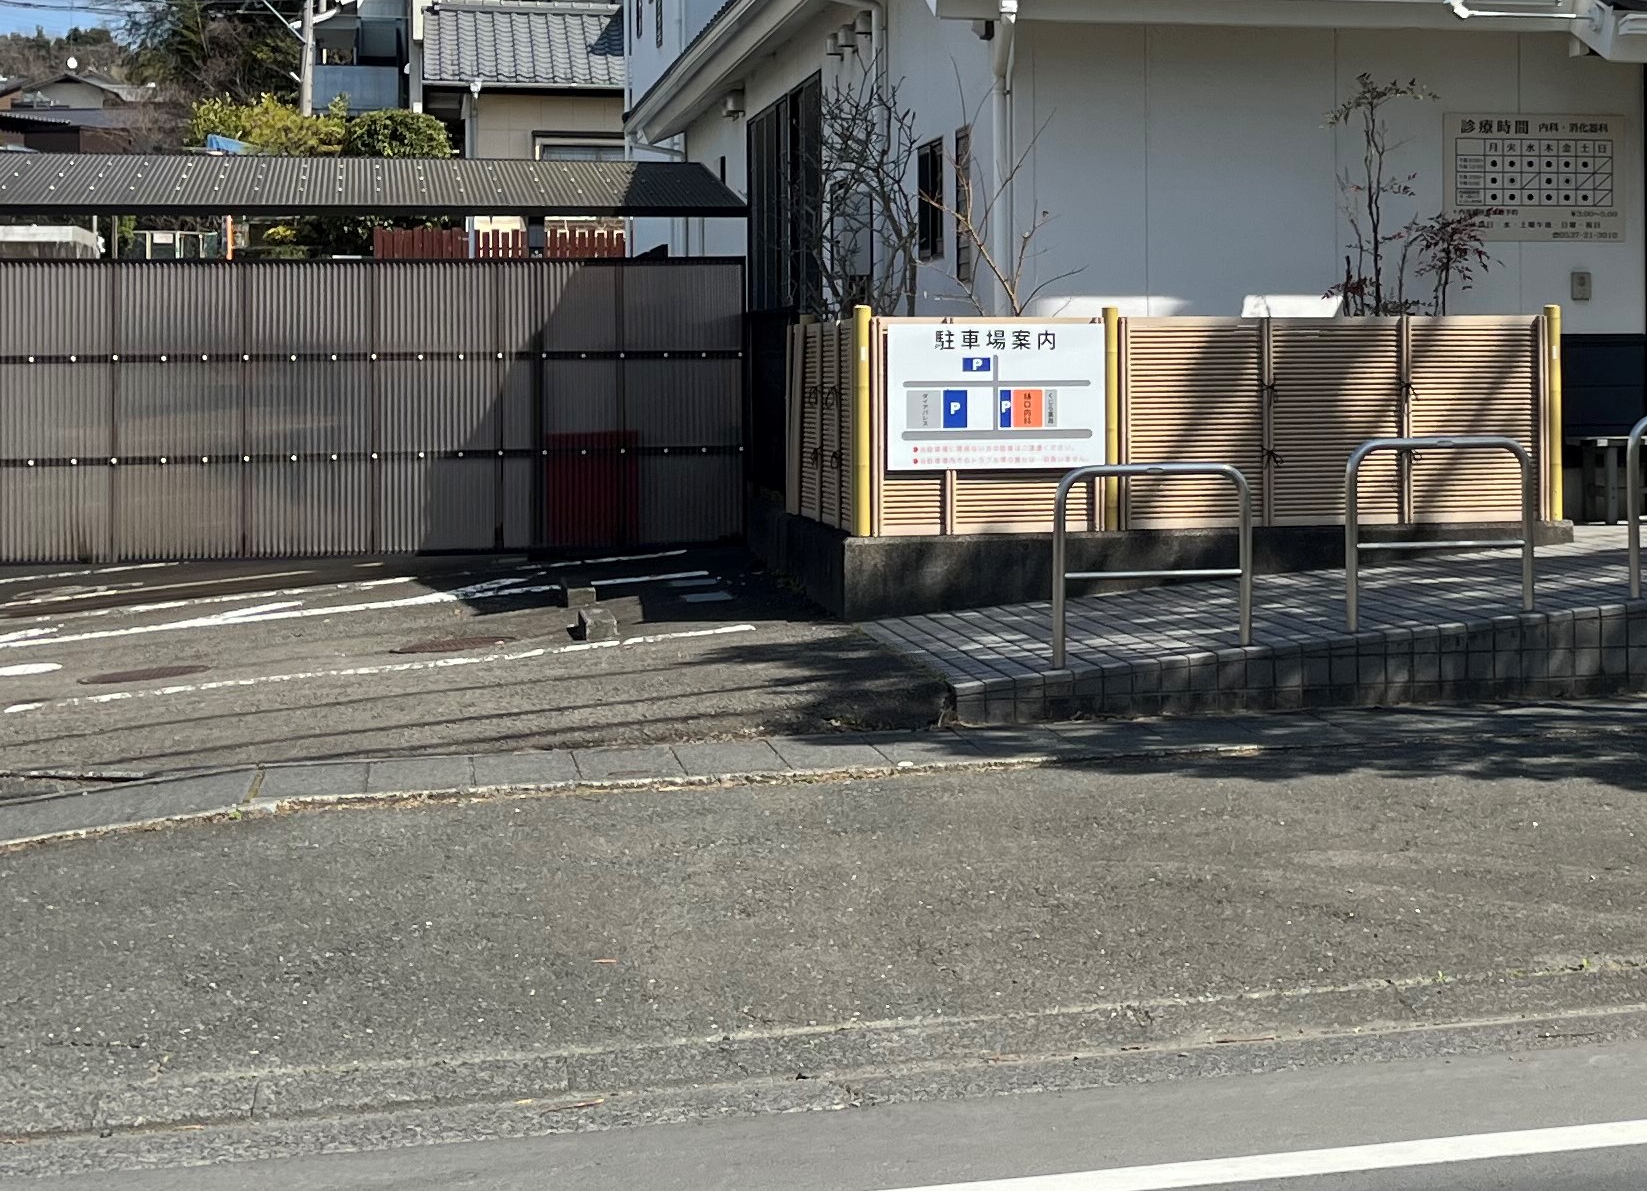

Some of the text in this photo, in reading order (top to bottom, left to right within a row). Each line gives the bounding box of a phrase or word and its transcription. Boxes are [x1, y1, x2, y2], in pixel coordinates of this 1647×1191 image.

[1460, 119, 1529, 135] 診療時間
[1489, 143, 1498, 152] 月
[1562, 143, 1572, 153] 金
[1581, 144, 1590, 153] 土
[1598, 144, 1607, 153] 日
[934, 329, 1056, 351] 駐車場案内
[972, 358, 983, 370] P
[950, 402, 961, 415] P
[1001, 401, 1011, 413] P
